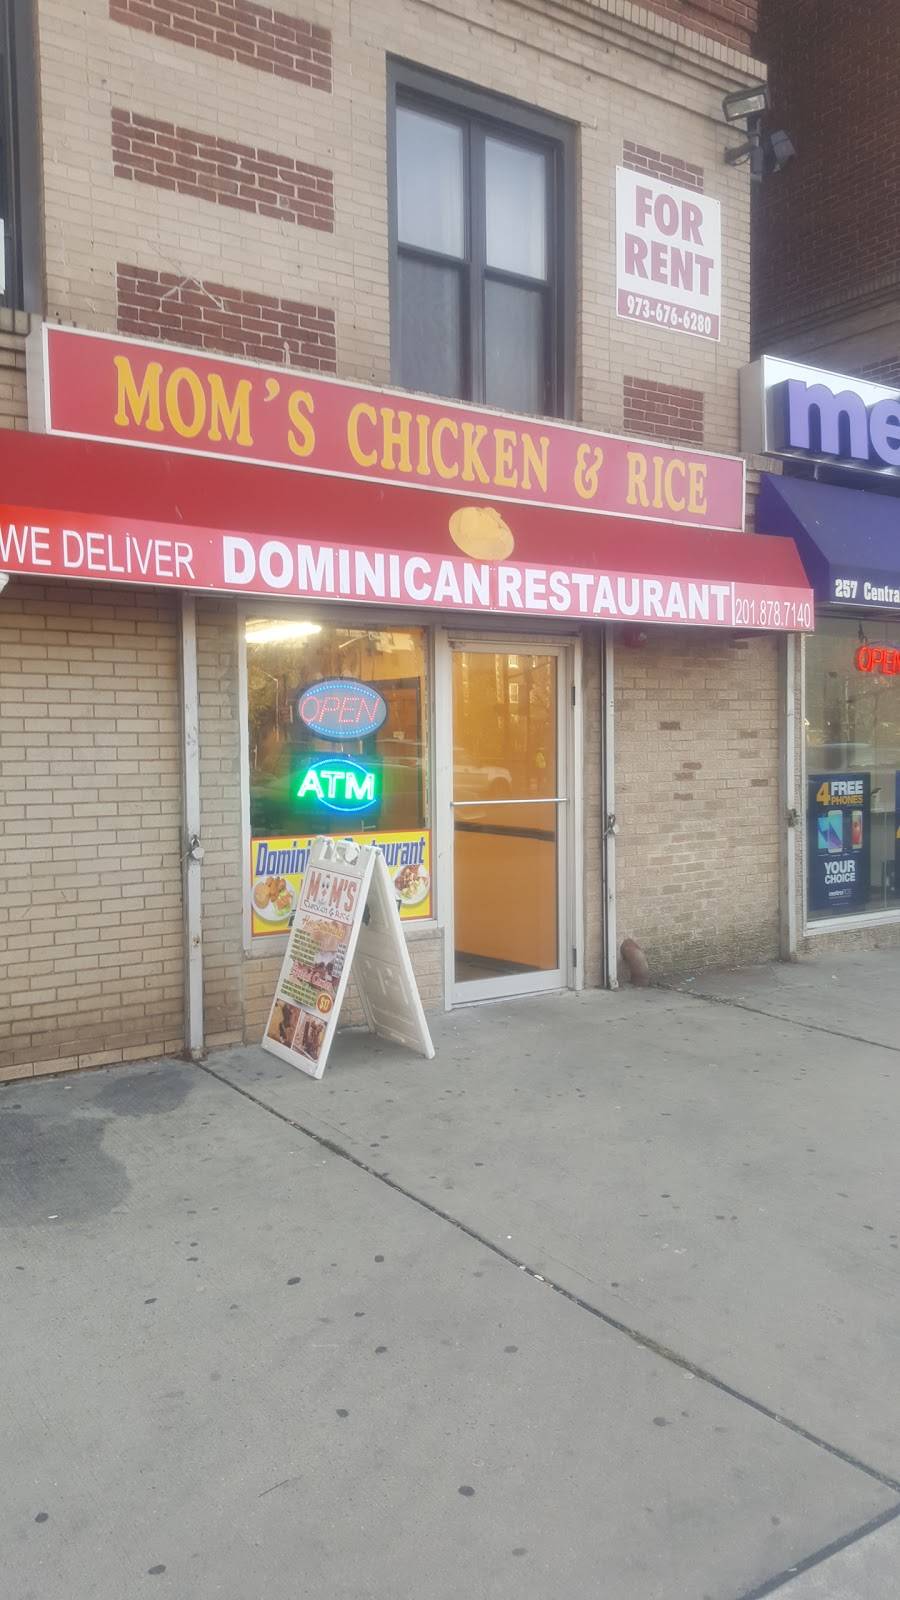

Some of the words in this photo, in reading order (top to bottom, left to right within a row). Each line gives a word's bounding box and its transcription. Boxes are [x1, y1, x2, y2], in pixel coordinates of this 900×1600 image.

[635, 185, 704, 246] FOR
[625, 232, 714, 296] RENT
[627, 294, 712, 335] 973-676-6280
[113, 355, 316, 458] MOM'S
[347, 402, 550, 493] CHICKEN
[574, 443, 604, 500] &
[626, 451, 709, 515] RICE
[0, 523, 52, 567] WE
[222, 535, 490, 607] DOMINICAN
[496, 566, 731, 622] RESTAURANT
[834, 579, 858, 599] 257
[735, 598, 811, 628] 201.878.7140
[855, 645, 900, 675] OPE
[301, 695, 380, 724] OPEN
[297, 769, 375, 801] ATM
[816, 781, 831, 806] 4
[831, 780, 864, 796] FREE
[831, 794, 864, 806] PHONES
[824, 860, 855, 874] YOUR
[824, 873, 856, 885] CHOICE
